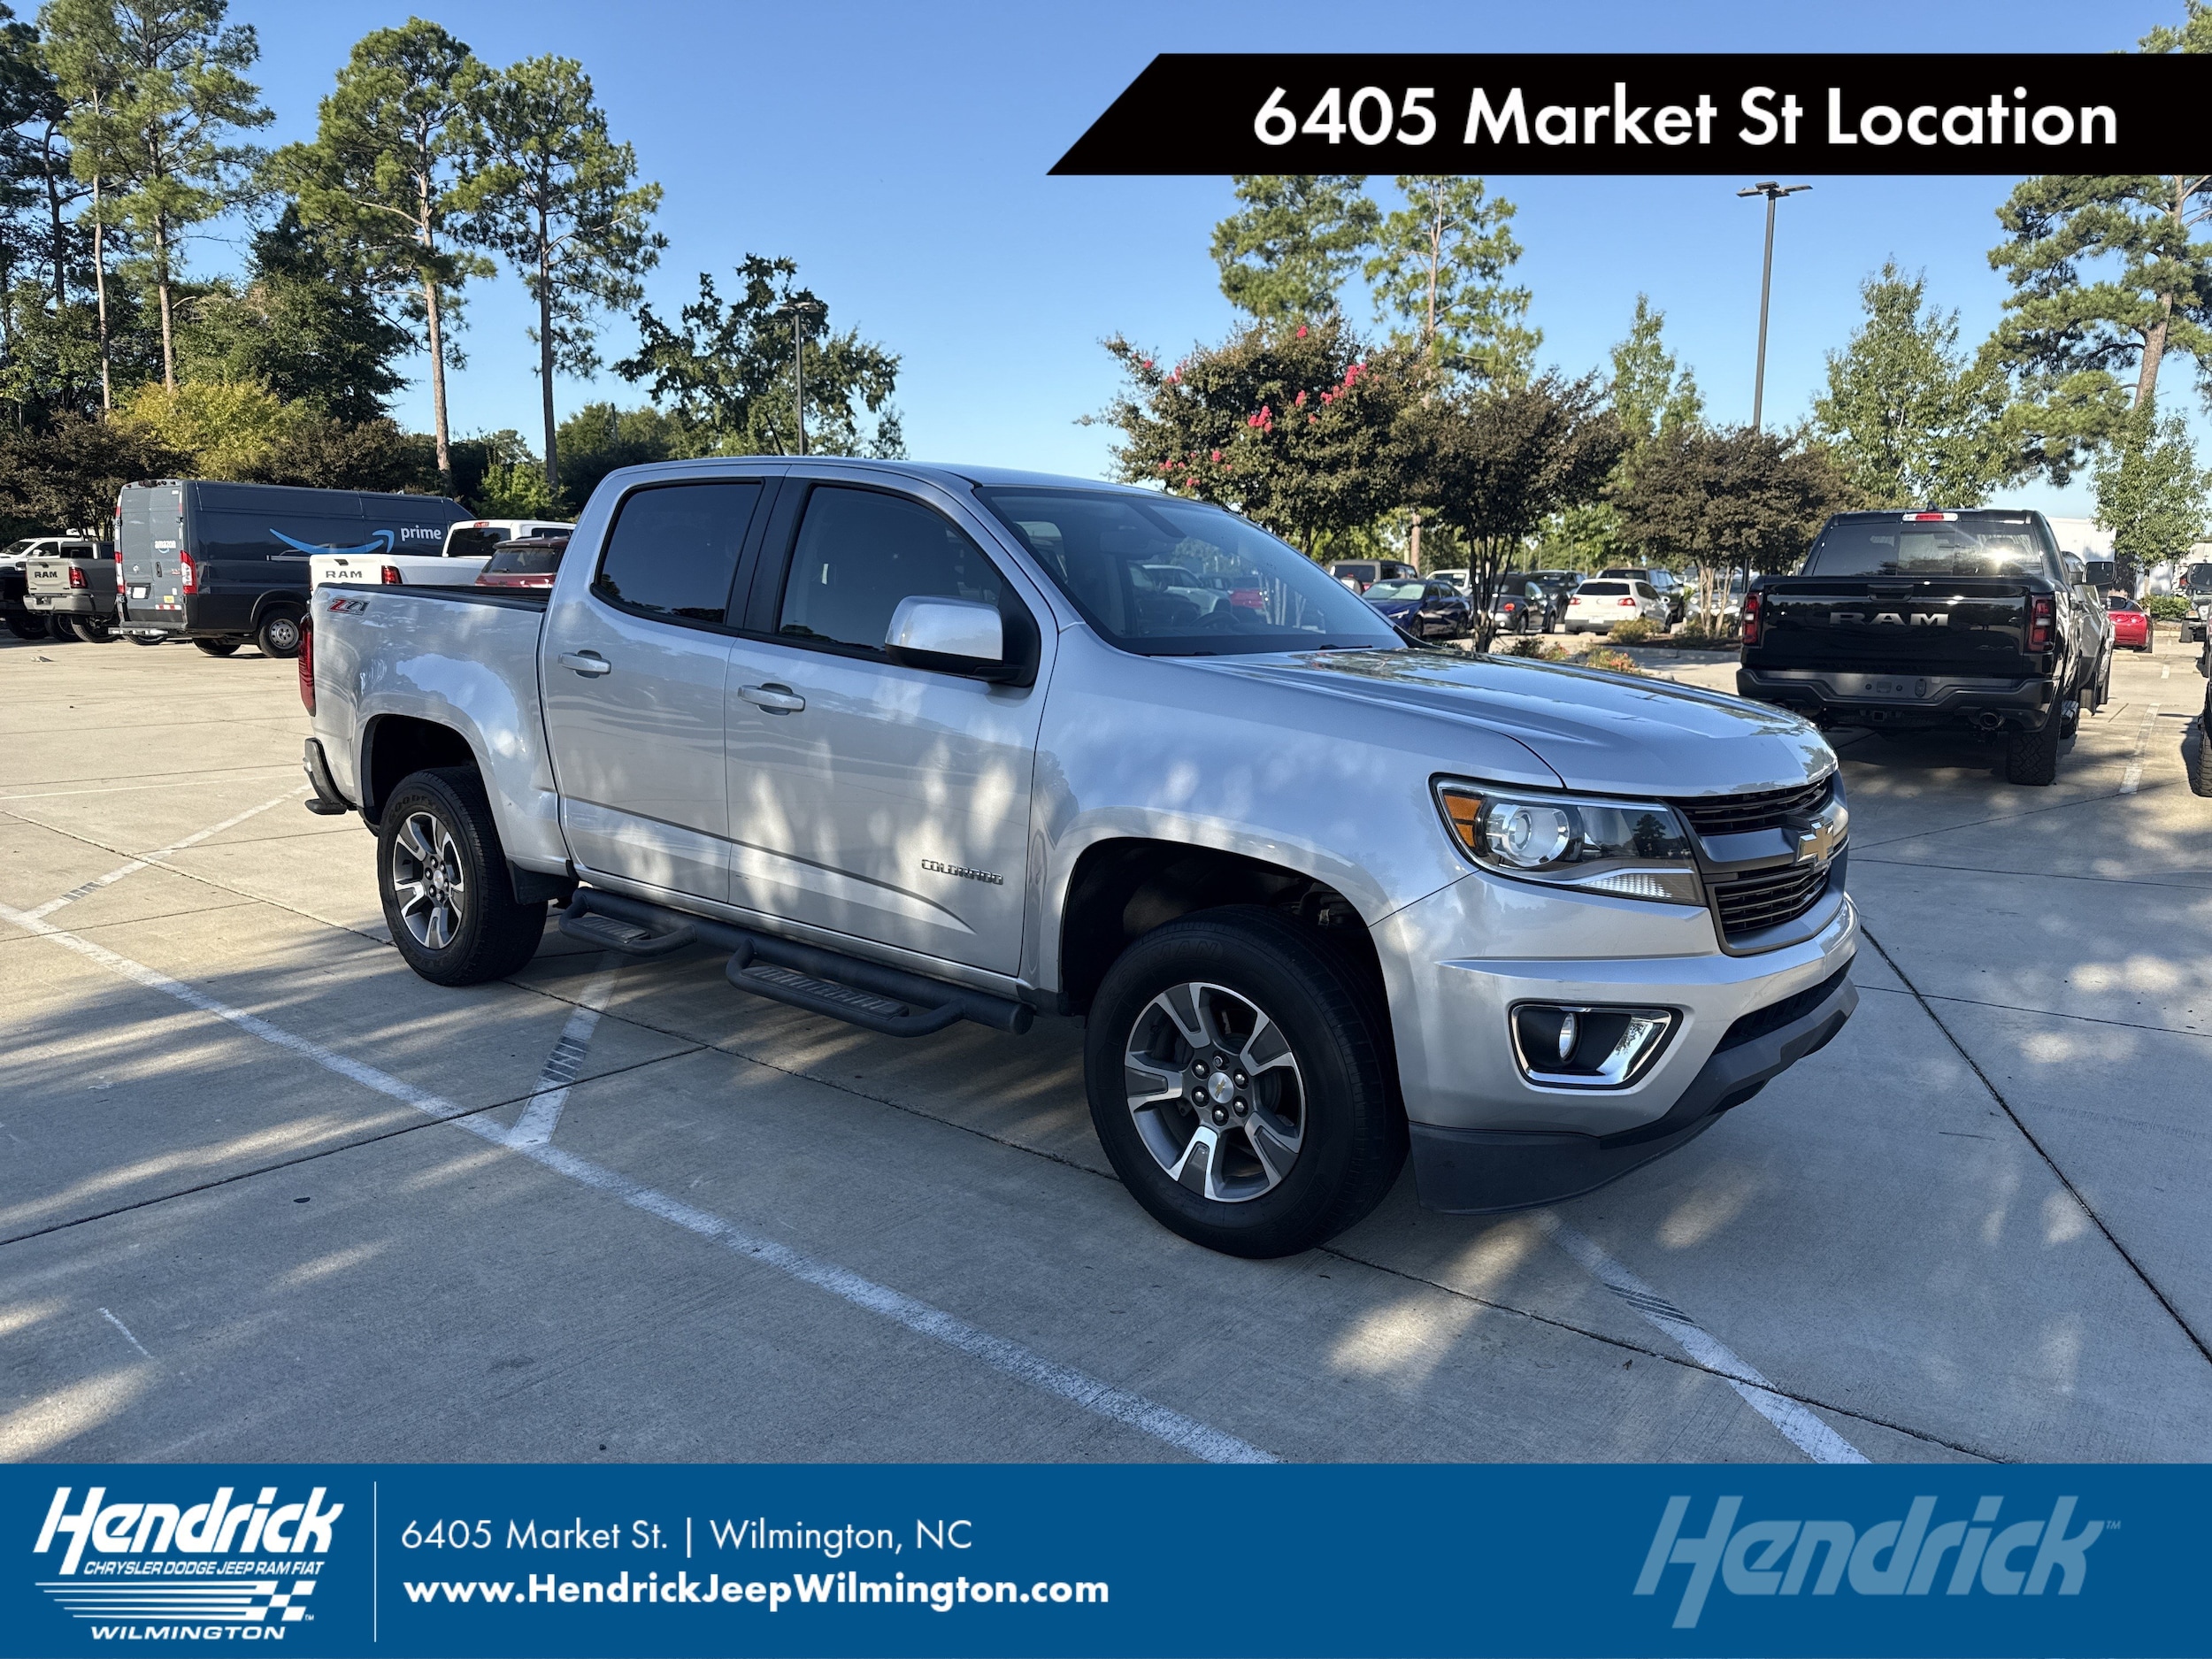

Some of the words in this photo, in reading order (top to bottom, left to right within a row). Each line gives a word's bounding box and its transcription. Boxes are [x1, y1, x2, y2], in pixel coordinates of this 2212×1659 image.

[401, 525, 442, 541] prime
[327, 597, 371, 615] Z71
[1829, 611, 1949, 626] RAM
[921, 858, 1004, 886] COLORADO
